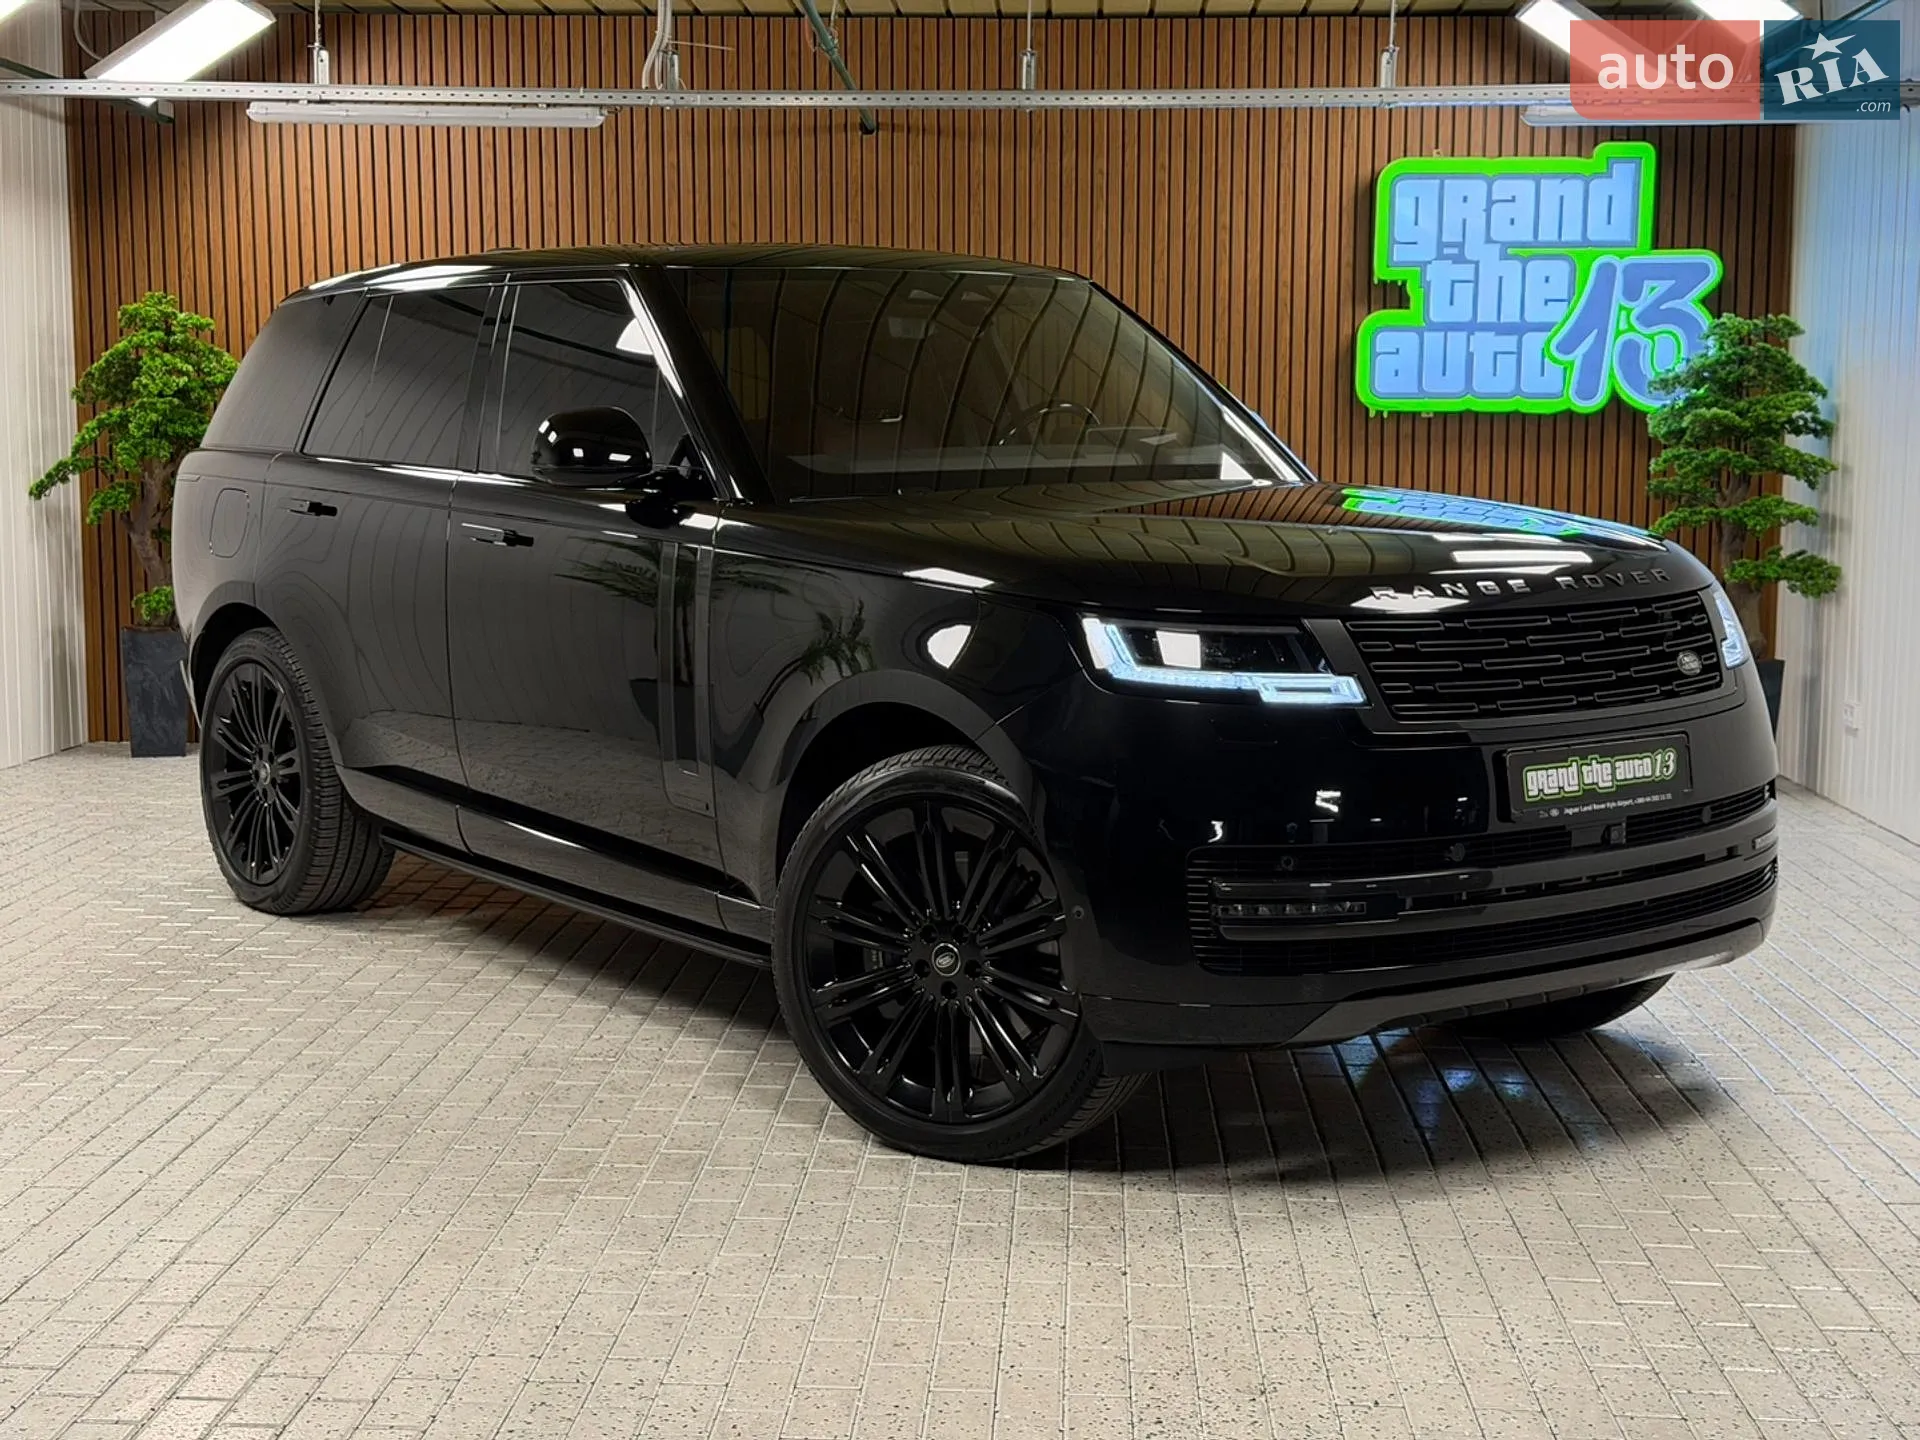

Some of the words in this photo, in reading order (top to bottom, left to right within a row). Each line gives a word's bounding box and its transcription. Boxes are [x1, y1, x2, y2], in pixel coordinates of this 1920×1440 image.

[1393, 160, 1638, 261] grand
[1424, 252, 1576, 323] the
[1373, 330, 1567, 394] auto
[1553, 256, 1721, 406] 13
[1369, 577, 1532, 600] RANGE
[1555, 567, 1672, 591] ROVER
[1526, 761, 1580, 797] grand
[1581, 760, 1613, 788] the
[1615, 757, 1653, 780] auto
[1654, 751, 1676, 778] 13
